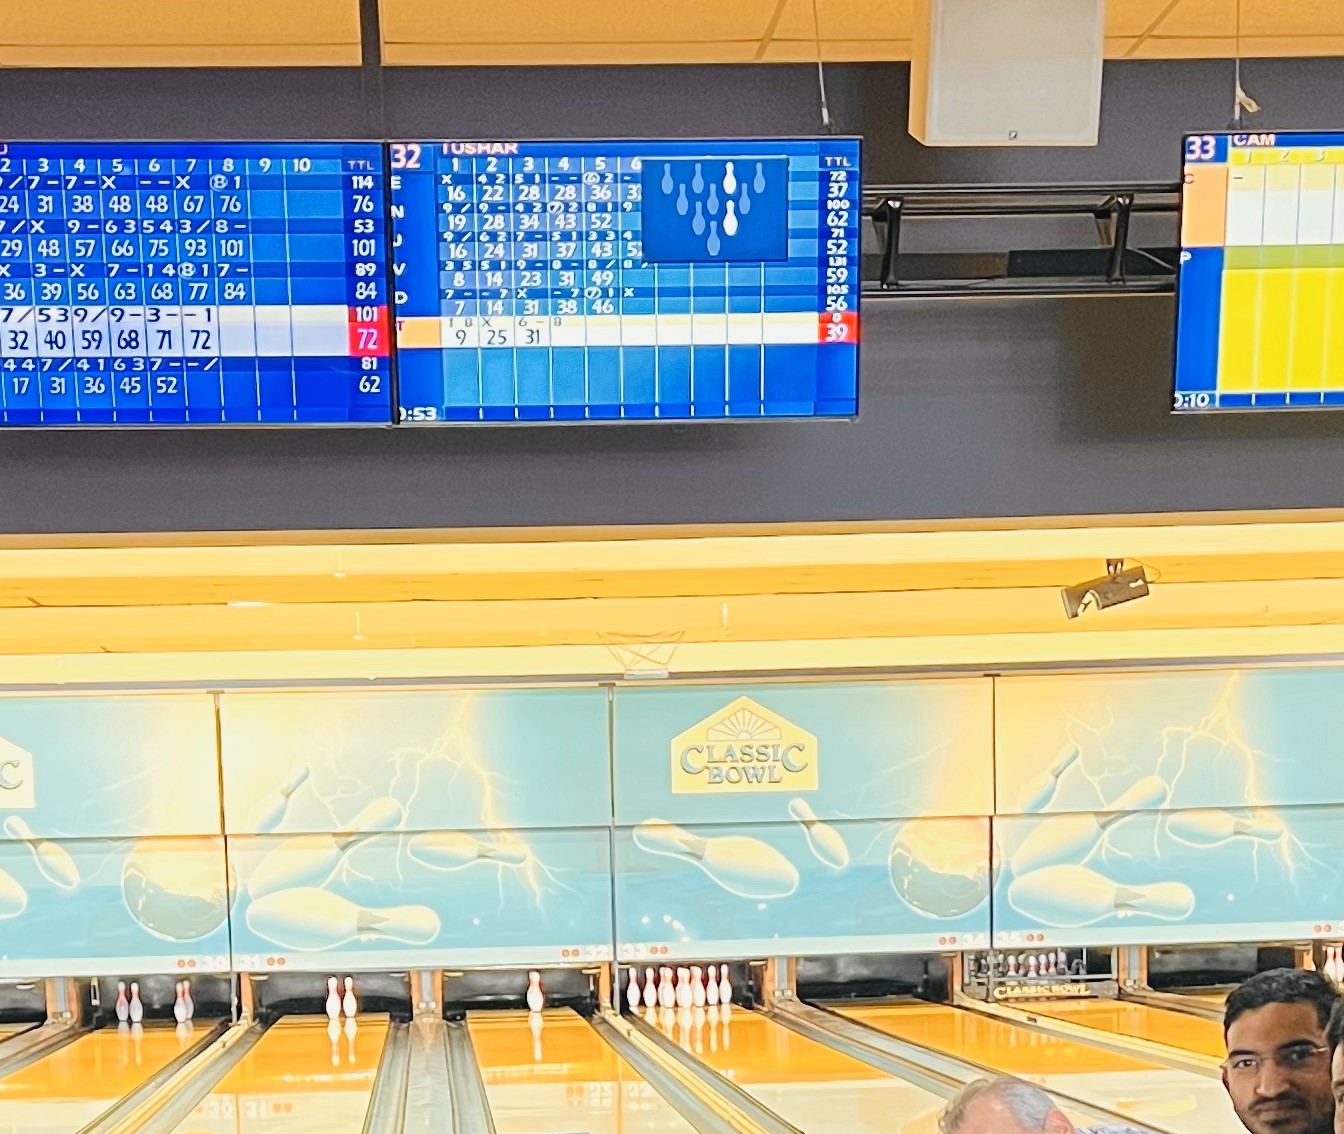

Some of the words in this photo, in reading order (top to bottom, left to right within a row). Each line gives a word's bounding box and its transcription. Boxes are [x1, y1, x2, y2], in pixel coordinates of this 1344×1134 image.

[442, 142, 518, 155] TUSHAR
[1184, 134, 1217, 162] 33
[1231, 133, 1277, 148] CAM
[0, 157, 11, 173] 2
[37, 157, 49, 173] 3
[73, 158, 86, 173] 4
[112, 158, 123, 173] 5
[148, 158, 161, 173] 6
[186, 158, 197, 173] 7
[222, 157, 235, 173] 8
[258, 157, 272, 173] 9
[293, 157, 311, 173] 10
[347, 159, 374, 171] TTL
[390, 143, 422, 169] 32
[825, 156, 851, 167] TTL
[351, 175, 374, 190] 114
[447, 185, 466, 201] 16
[481, 184, 505, 201] 22
[517, 184, 541, 201] 28
[554, 184, 577, 201] 28
[590, 184, 612, 201] 36
[827, 181, 849, 198] 37
[37, 194, 53, 213] 31
[71, 194, 94, 213] 38
[108, 195, 132, 213] 48
[145, 194, 169, 213] 48
[183, 195, 204, 213] 67
[219, 195, 242, 213] 76
[352, 195, 374, 213] 76
[353, 218, 375, 234] 53
[447, 214, 467, 231] 19
[482, 214, 506, 231] 28
[519, 214, 541, 230] 34
[554, 214, 577, 230] 43
[590, 214, 612, 230] 52
[826, 210, 849, 227] 62
[0, 239, 23, 257] 29
[37, 239, 60, 257] 48
[75, 239, 96, 258] 57
[111, 239, 134, 257] 66
[148, 239, 169, 257] 75
[184, 238, 207, 257] 93
[219, 239, 243, 257] 101
[352, 238, 376, 257] 101
[826, 238, 848, 255] 52
[355, 262, 377, 277] 89
[826, 267, 849, 284] 59
[3, 282, 26, 301] 36
[41, 282, 62, 301] 39
[77, 283, 100, 301] 56
[114, 282, 136, 300] 63
[151, 282, 174, 300] 68
[188, 282, 209, 301] 77
[223, 282, 246, 301] 84
[355, 281, 378, 300] 84
[825, 295, 848, 312] 56
[355, 305, 378, 323] 101
[8, 329, 29, 351] 32
[43, 329, 67, 351] 40
[81, 329, 103, 350] 59
[117, 329, 140, 350] 68
[156, 329, 172, 350] 71
[190, 329, 211, 350] 72
[357, 328, 379, 350] 72
[825, 322, 849, 343] 39
[361, 356, 378, 371] 81
[12, 377, 30, 395] 17
[50, 376, 66, 394] 31
[83, 376, 106, 394] 36
[119, 376, 141, 394] 45
[156, 376, 178, 394] 52
[358, 376, 381, 393] 62
[680, 744, 808, 774] CLASSIC
[706, 766, 782, 784] BOWL
